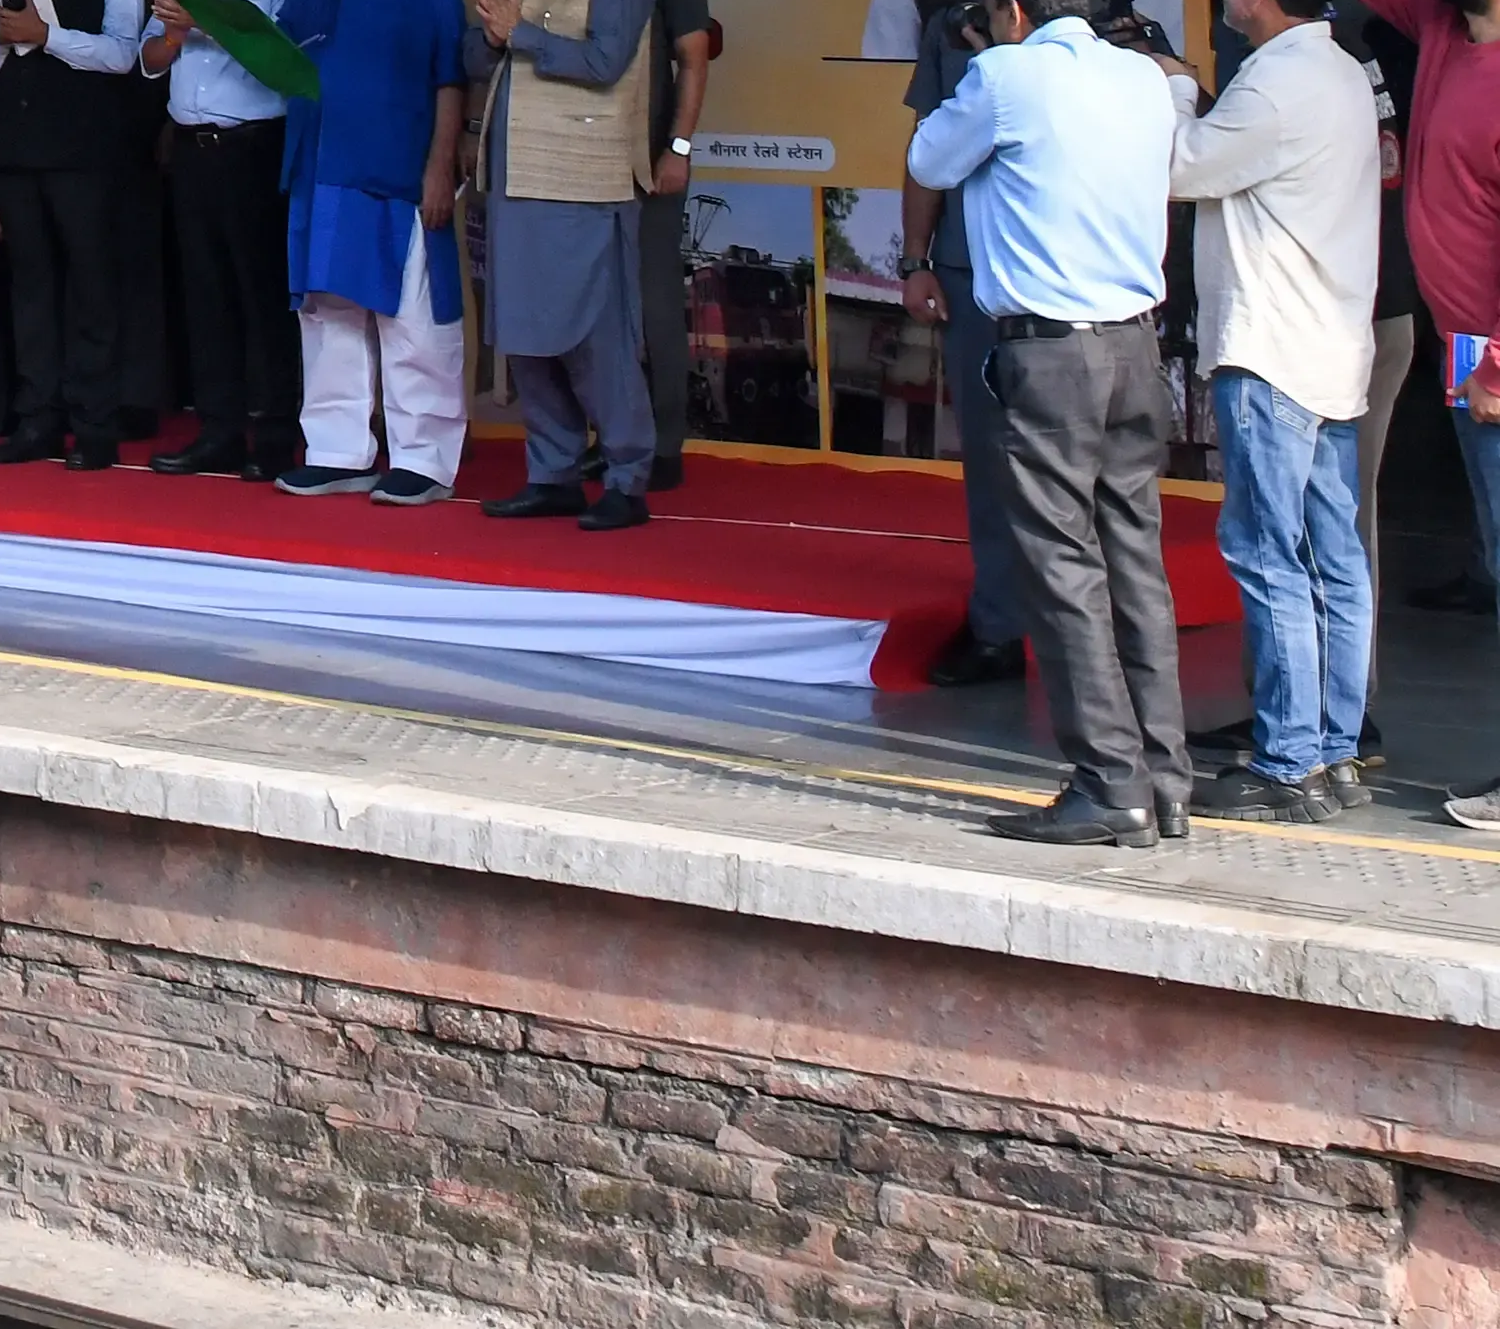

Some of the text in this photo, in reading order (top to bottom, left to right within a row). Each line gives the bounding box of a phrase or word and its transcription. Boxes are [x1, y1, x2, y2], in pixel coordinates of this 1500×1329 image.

[709, 141, 823, 160] श्रीनगर रेलवे स्टेशन
